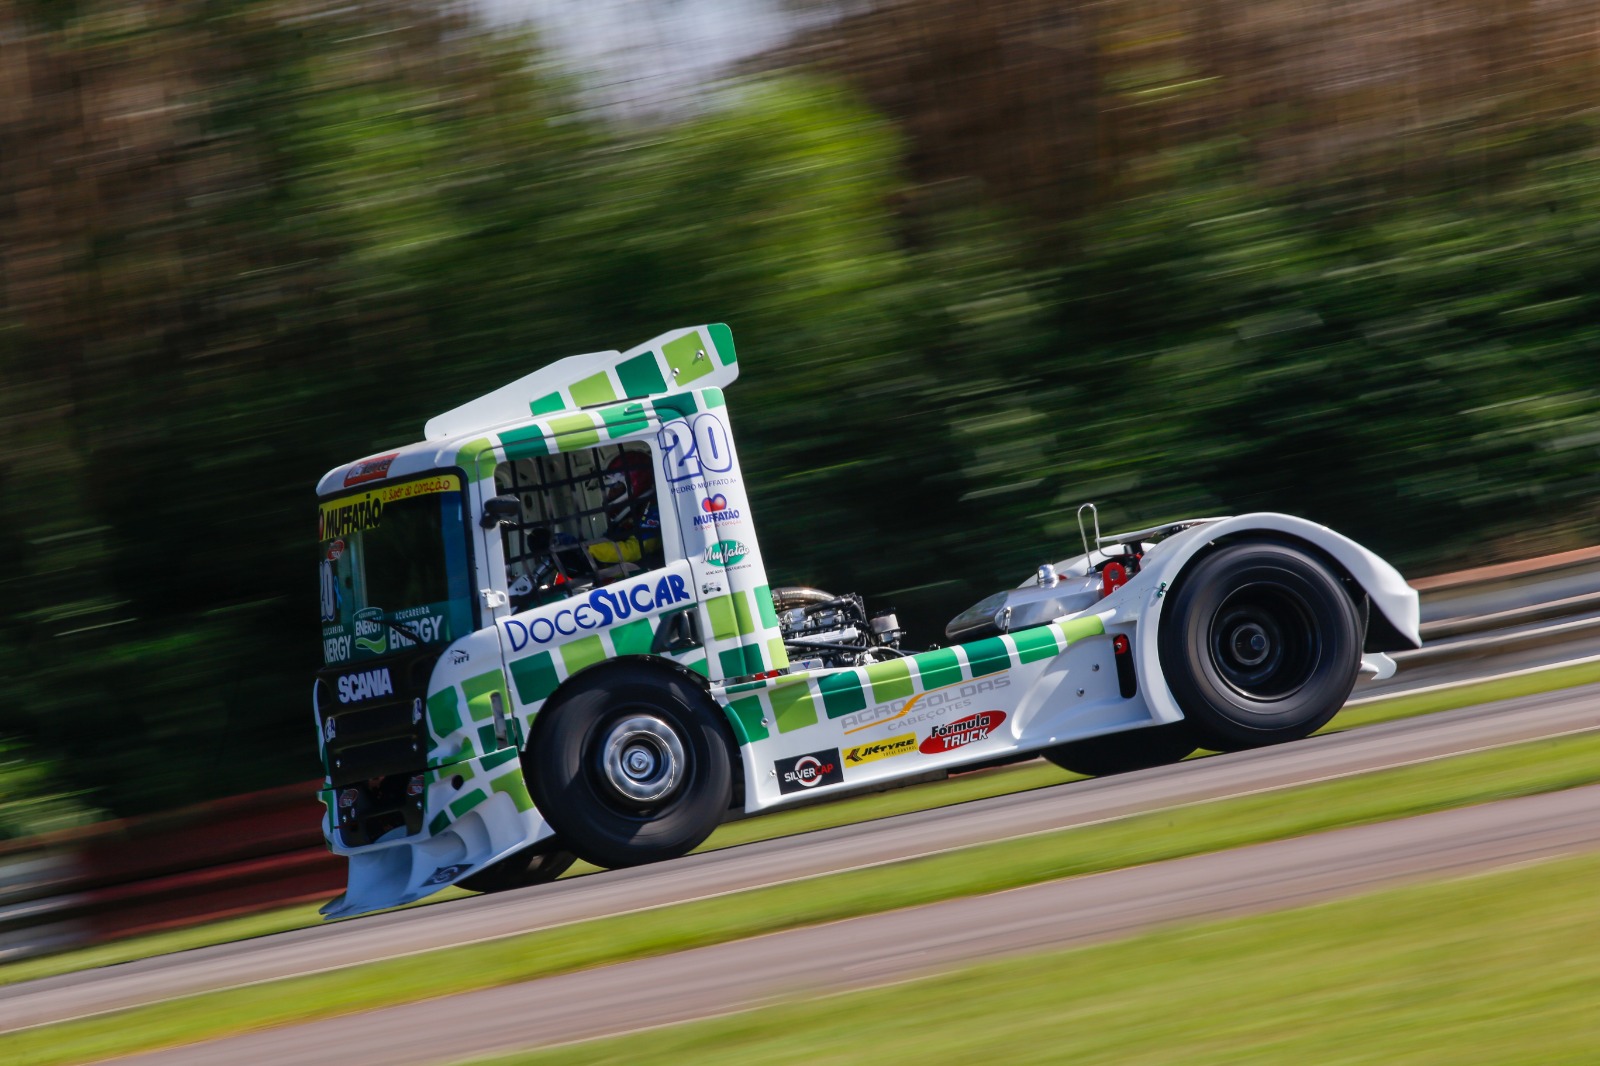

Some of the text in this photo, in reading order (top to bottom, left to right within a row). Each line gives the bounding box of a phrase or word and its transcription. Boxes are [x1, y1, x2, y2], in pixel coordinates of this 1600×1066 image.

[657, 413, 733, 483] 20
[671, 484, 696, 495] PEDRO
[698, 479, 729, 489] MUFFATO
[325, 493, 381, 540] MUFFATÃO
[693, 508, 740, 526] MUFFATÃO
[701, 541, 750, 564] Muffatão
[323, 634, 351, 664] NERGY
[338, 667, 393, 704] SCANIA
[887, 698, 972, 731] CABEÇOTES
[931, 713, 991, 738] Fórmula
[942, 727, 989, 749] TRUCK
